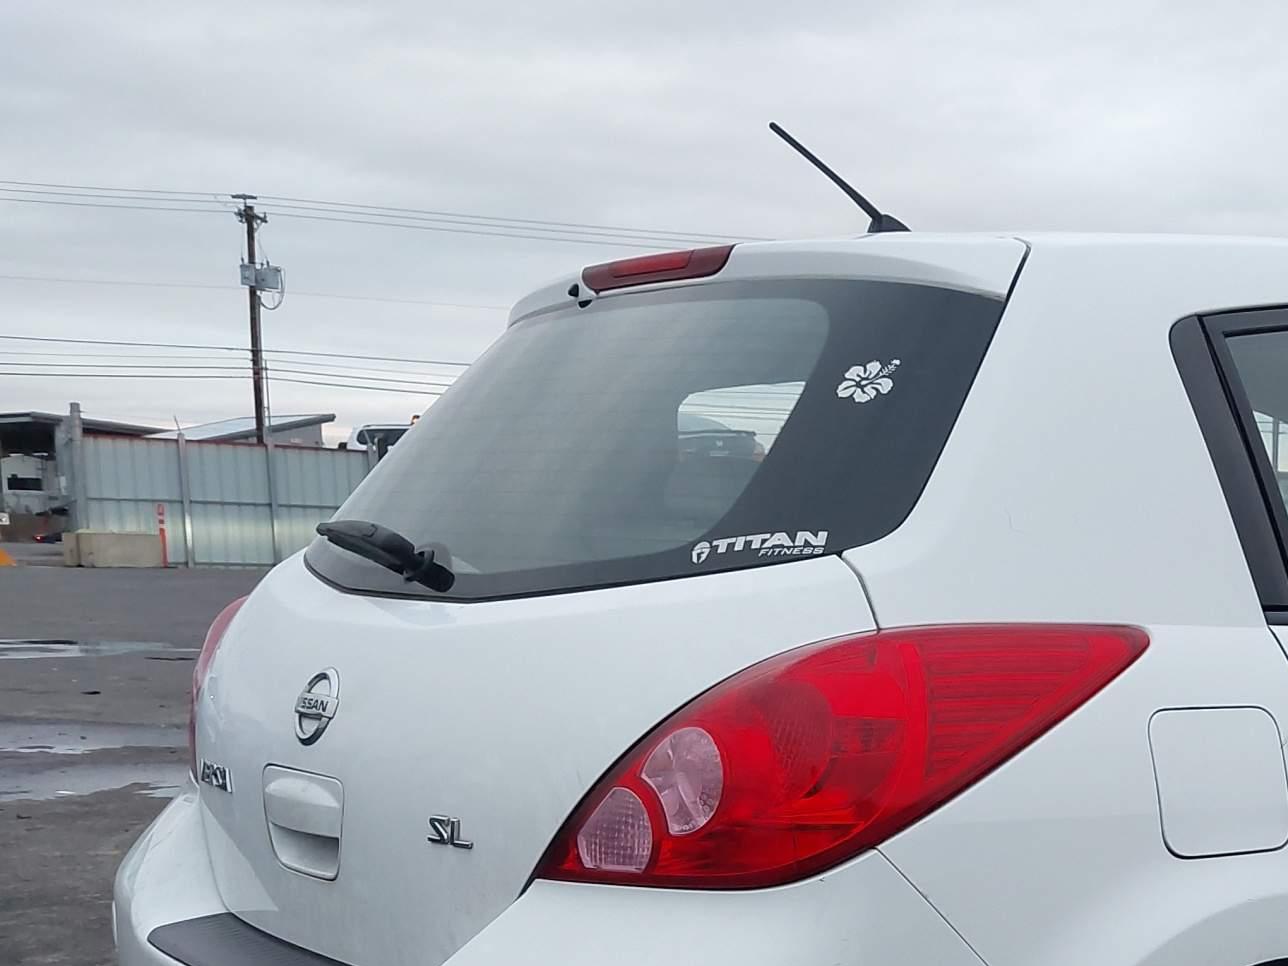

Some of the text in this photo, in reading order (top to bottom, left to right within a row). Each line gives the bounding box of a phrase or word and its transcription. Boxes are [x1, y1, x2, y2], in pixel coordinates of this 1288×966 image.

[712, 531, 829, 554] TITAN
[758, 547, 825, 558] FITNESS
[298, 697, 329, 713] SSAN
[427, 815, 474, 849] SL
